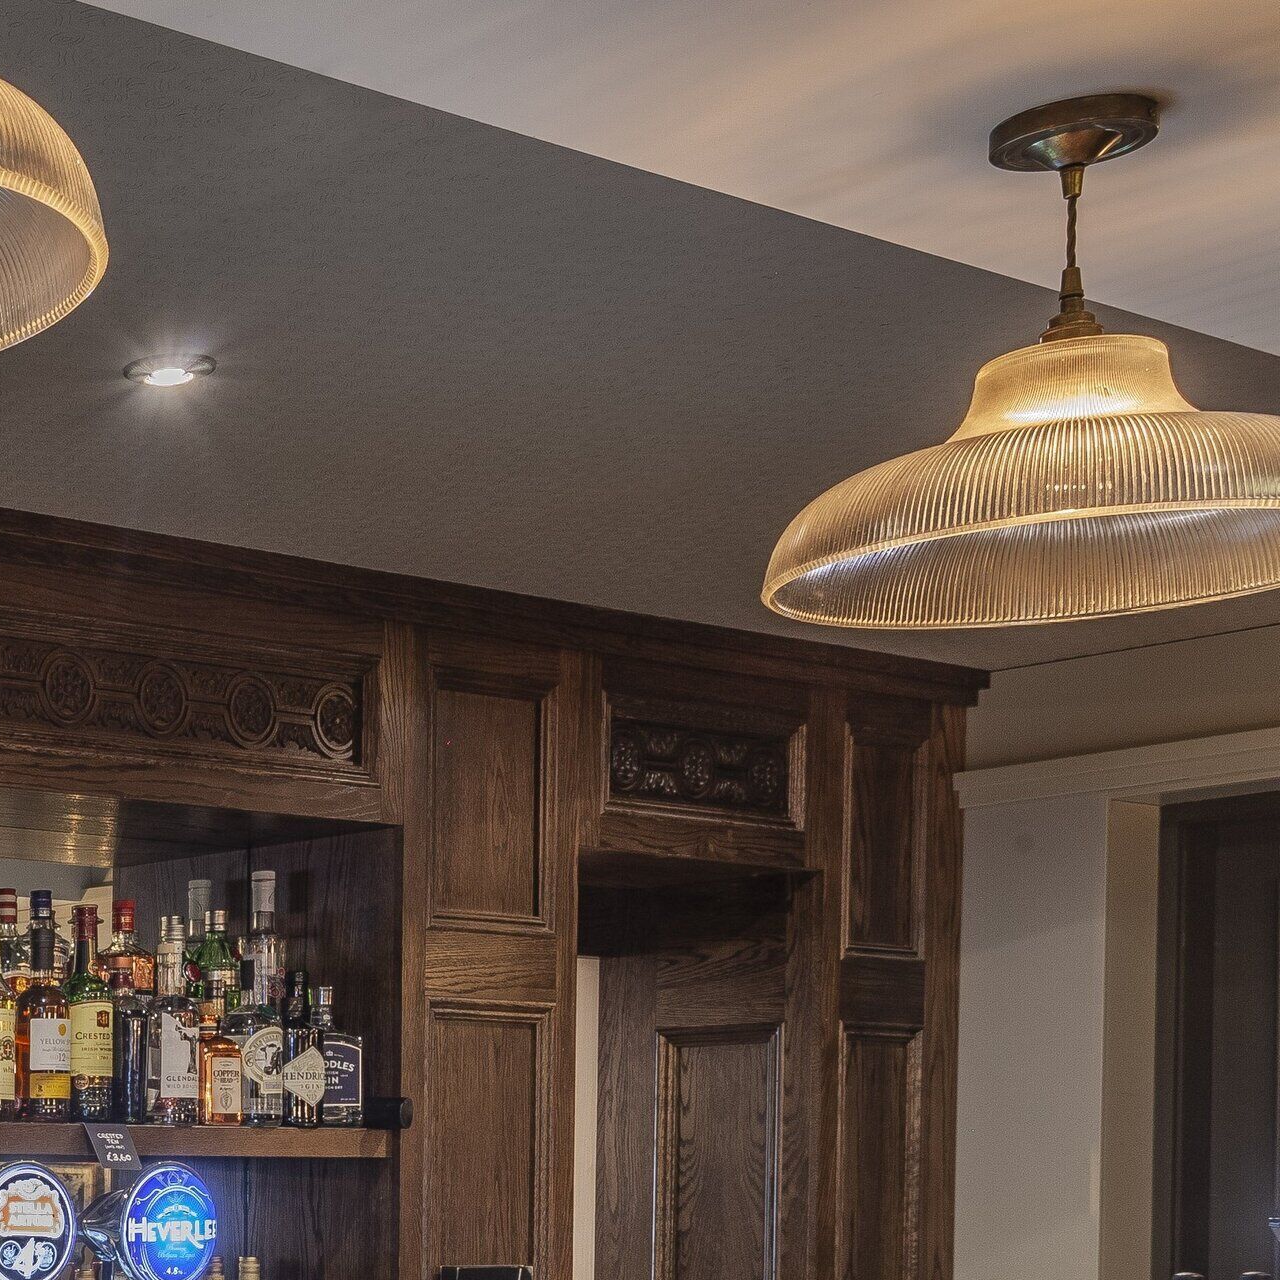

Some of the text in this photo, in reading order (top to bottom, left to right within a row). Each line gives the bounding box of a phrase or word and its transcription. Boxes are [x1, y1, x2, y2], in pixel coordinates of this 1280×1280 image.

[75, 1031, 111, 1040] CRESTED
[58, 1052, 66, 1062] 12
[213, 1069, 240, 1077] COPPER
[106, 1152, 132, 1162] £3.60
